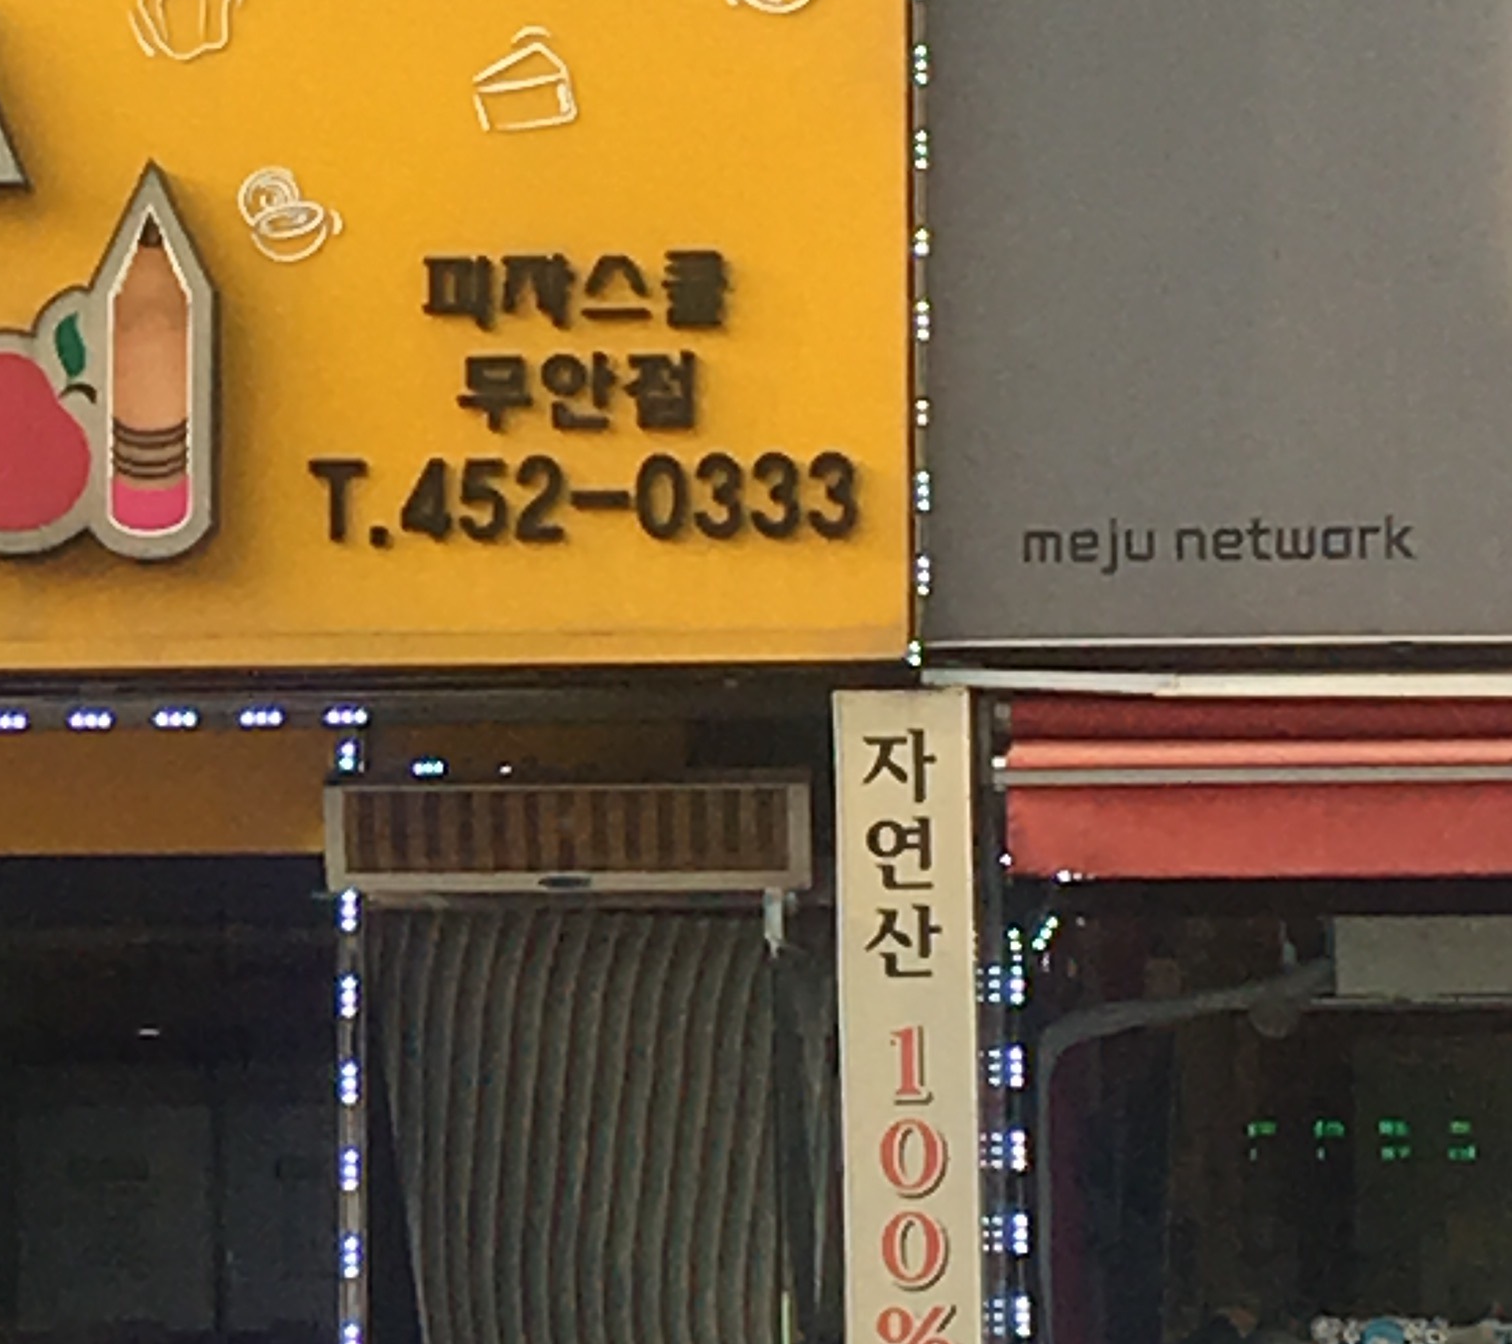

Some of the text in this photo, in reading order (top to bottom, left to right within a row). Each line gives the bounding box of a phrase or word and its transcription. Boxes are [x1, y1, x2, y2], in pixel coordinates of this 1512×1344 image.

[422, 249, 730, 331] 피자스쿨
[456, 349, 699, 432] 무안점
[1021, 517, 1156, 575] meju
[861, 727, 943, 979] 자연산
